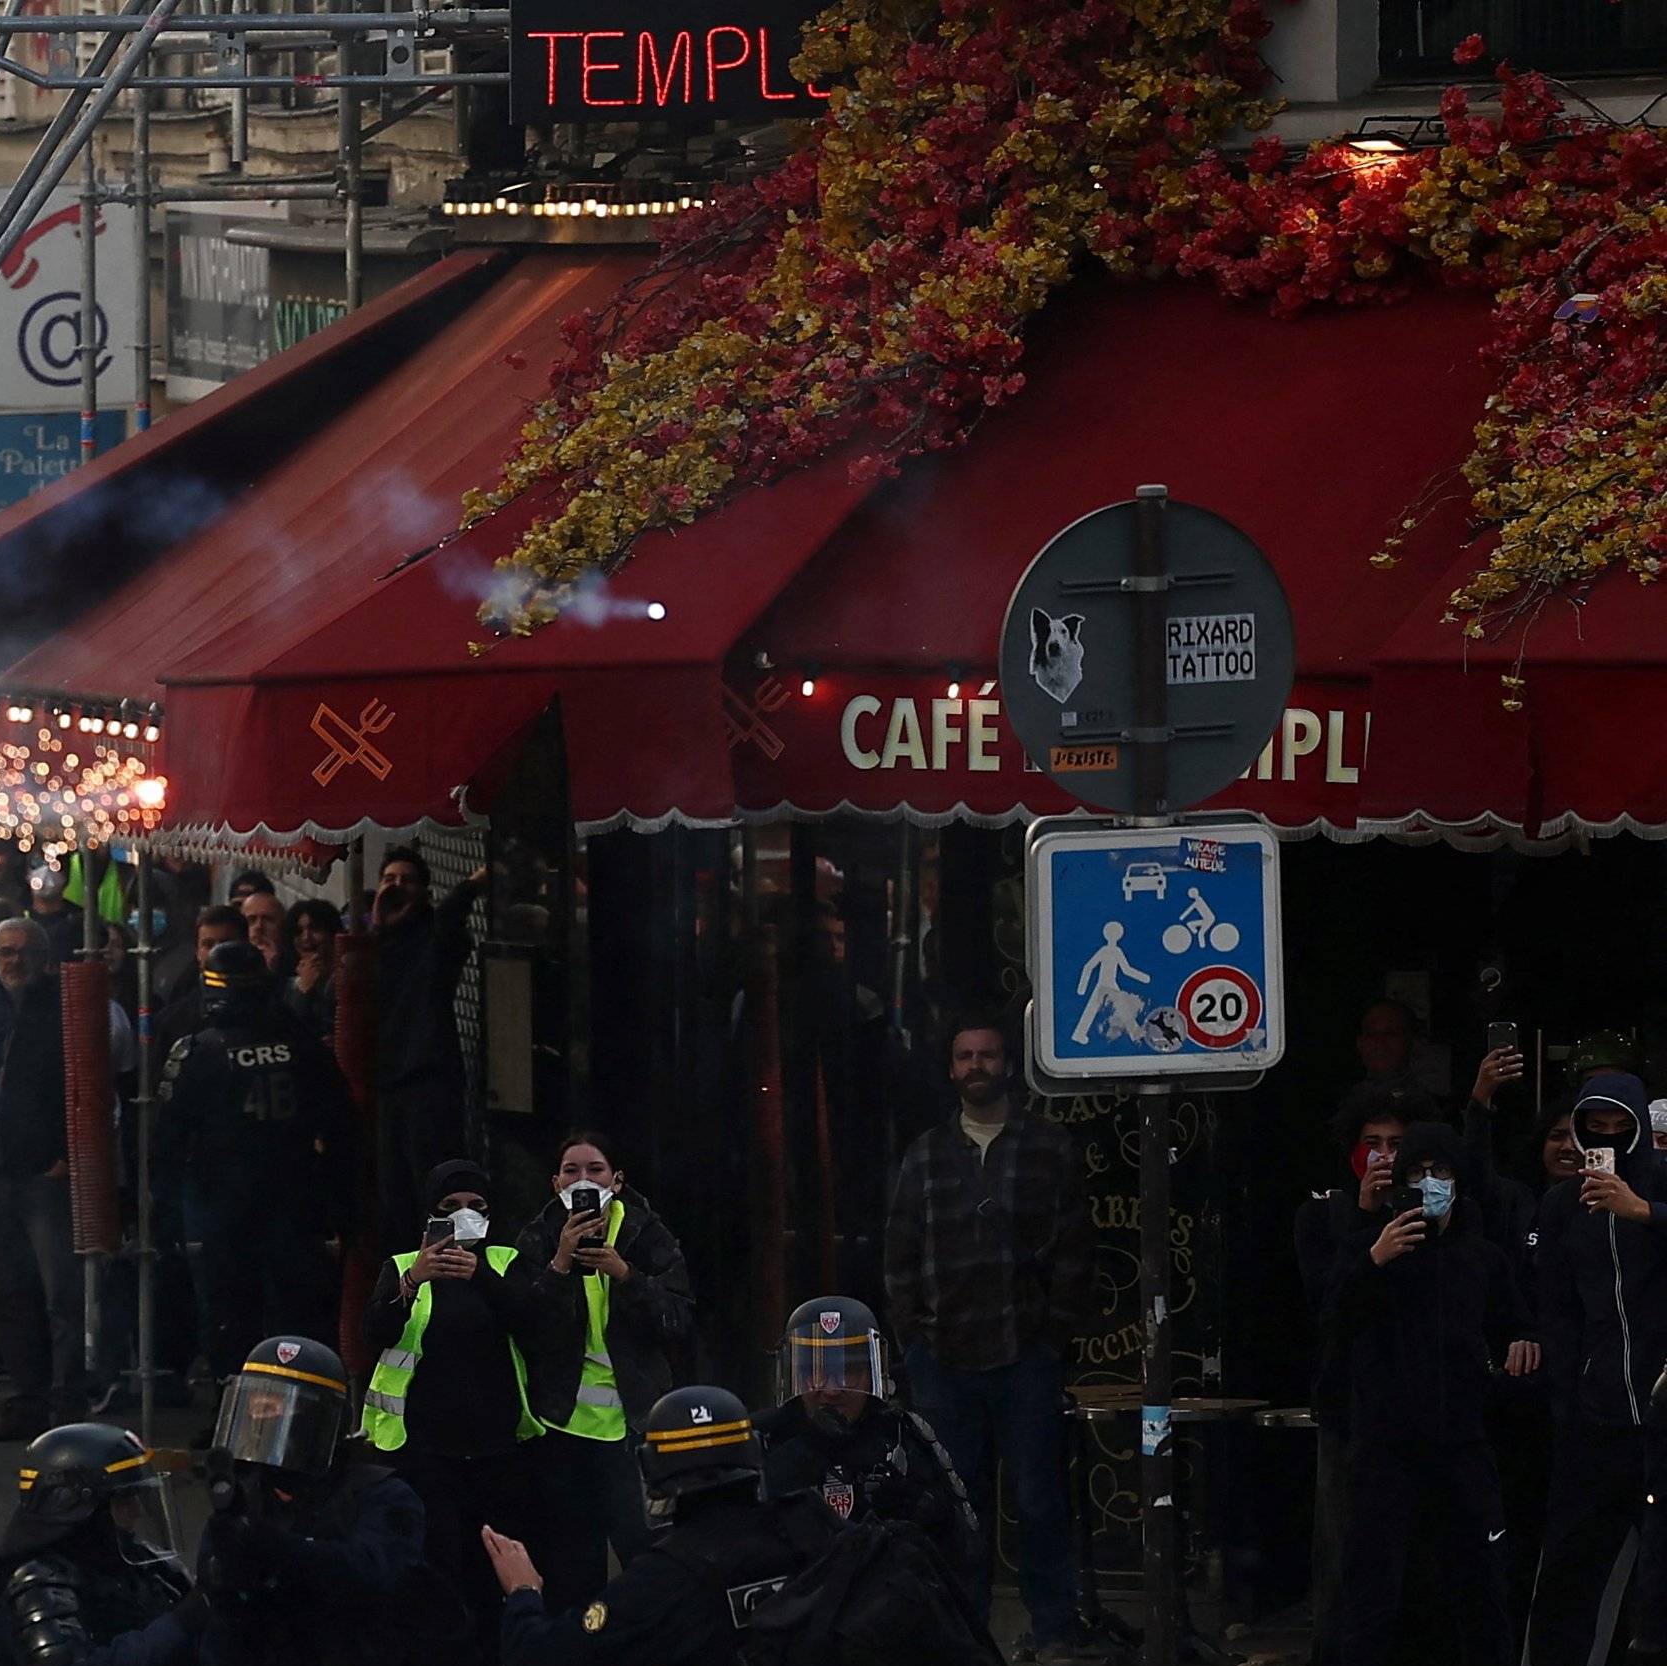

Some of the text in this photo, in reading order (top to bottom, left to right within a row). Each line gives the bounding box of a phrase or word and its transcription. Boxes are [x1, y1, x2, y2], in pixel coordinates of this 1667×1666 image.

[22, 424, 69, 451] La
[1167, 619, 1254, 648] RIXARD
[1168, 651, 1254, 679] TATTOO
[839, 680, 1001, 773] CAFÉ
[1195, 992, 1243, 1024] 20
[236, 1043, 292, 1068] CRS
[828, 1495, 851, 1507] CRS
